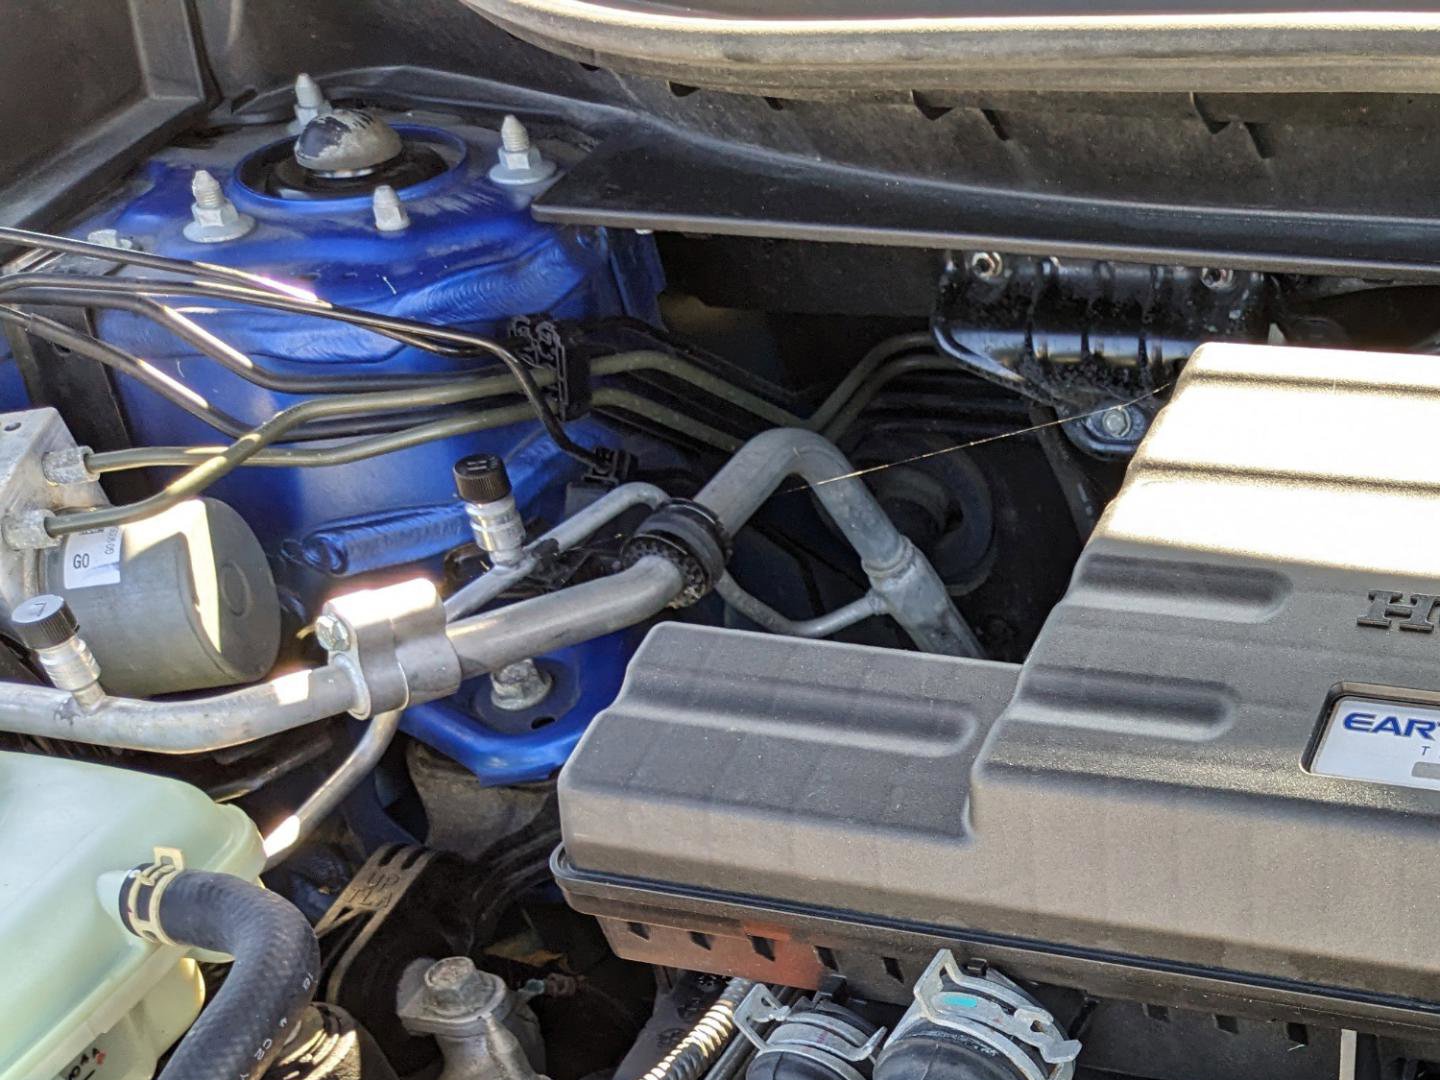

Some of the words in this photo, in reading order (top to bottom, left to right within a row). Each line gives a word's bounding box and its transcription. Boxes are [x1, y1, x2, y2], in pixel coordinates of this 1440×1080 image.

[367, 871, 401, 890] UP
[348, 888, 393, 908] TLA
[254, 1038, 273, 1060] C2
